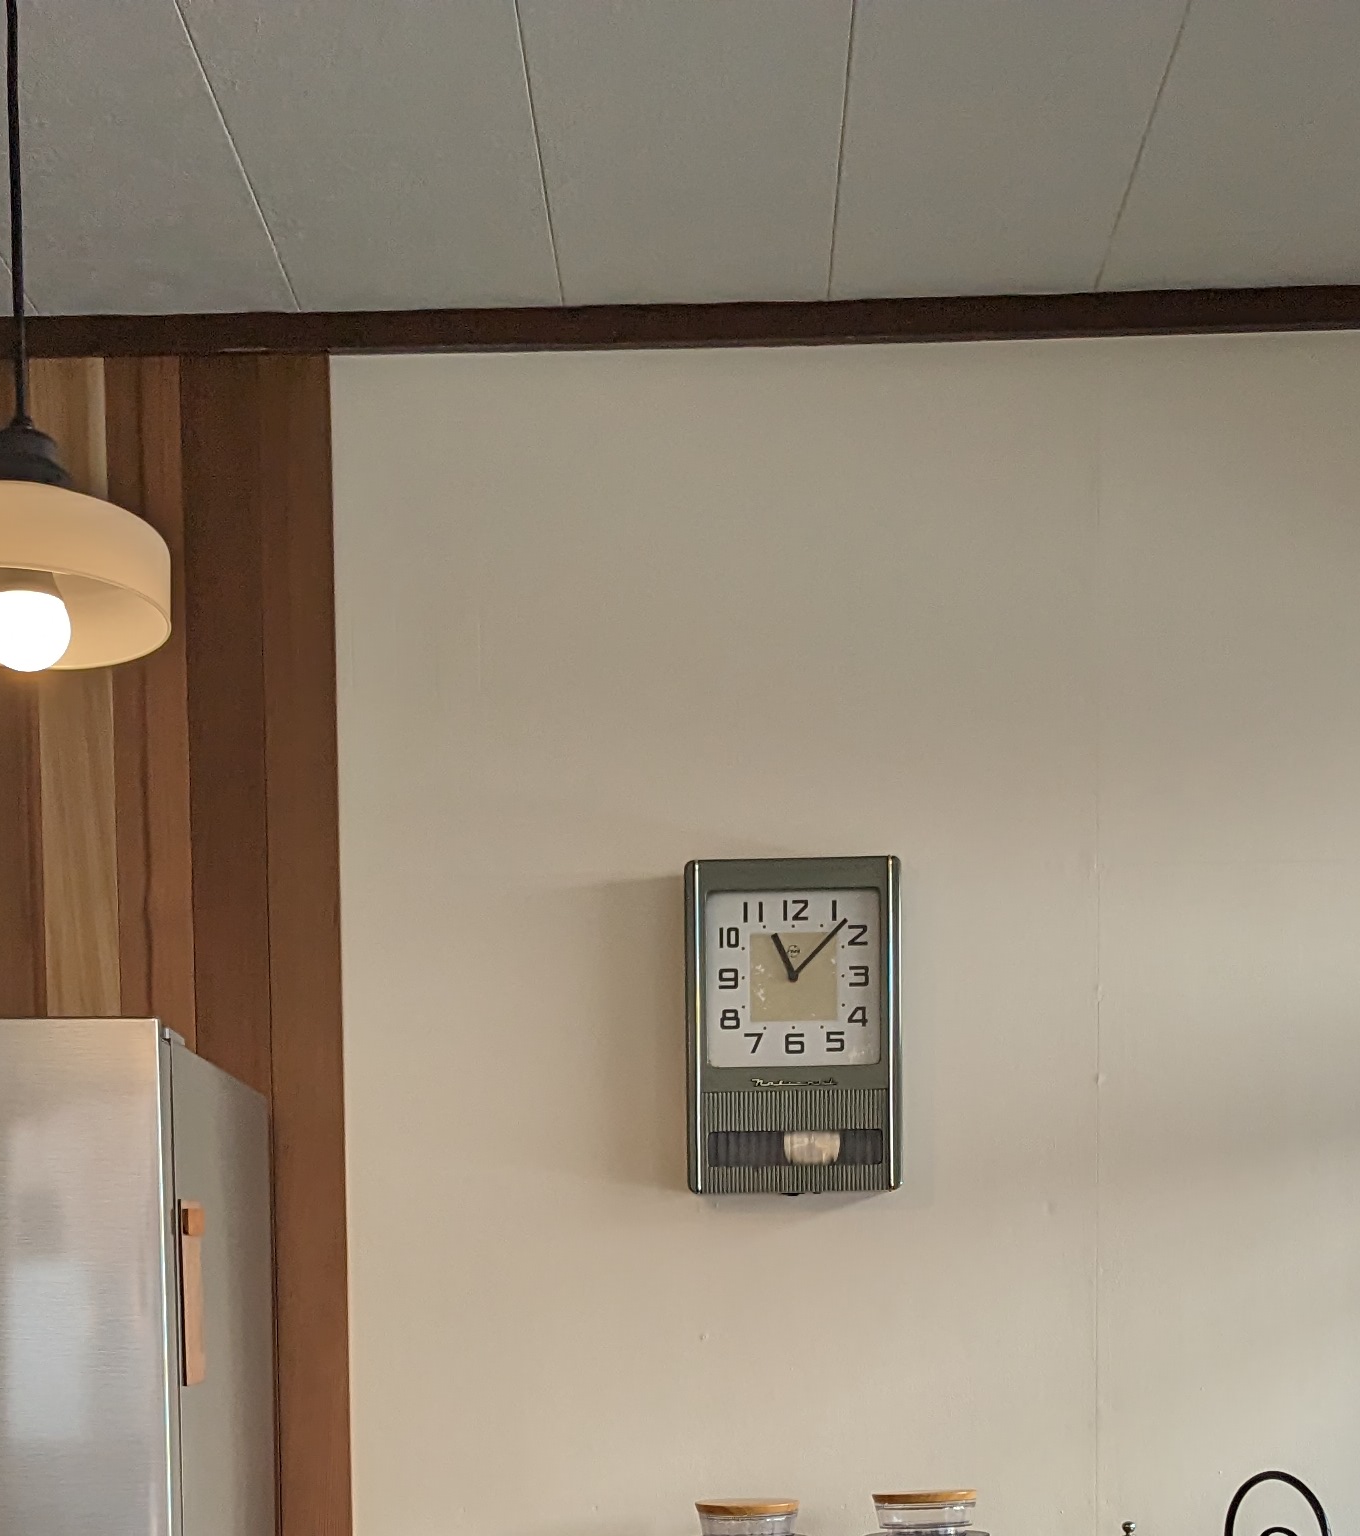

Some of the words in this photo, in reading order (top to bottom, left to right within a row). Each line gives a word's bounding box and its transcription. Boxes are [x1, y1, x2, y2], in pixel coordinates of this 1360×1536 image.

[743, 901, 764, 923] 11
[782, 900, 809, 921] 12
[831, 900, 838, 921] 1
[718, 927, 740, 949] 10
[847, 925, 869, 947] 2
[718, 968, 739, 990] 9
[848, 966, 870, 987] 3
[720, 1008, 741, 1030] 8
[847, 1006, 869, 1028] 4
[744, 1033, 764, 1054] 7
[784, 1033, 805, 1054] 6
[826, 1031, 846, 1052] 5
